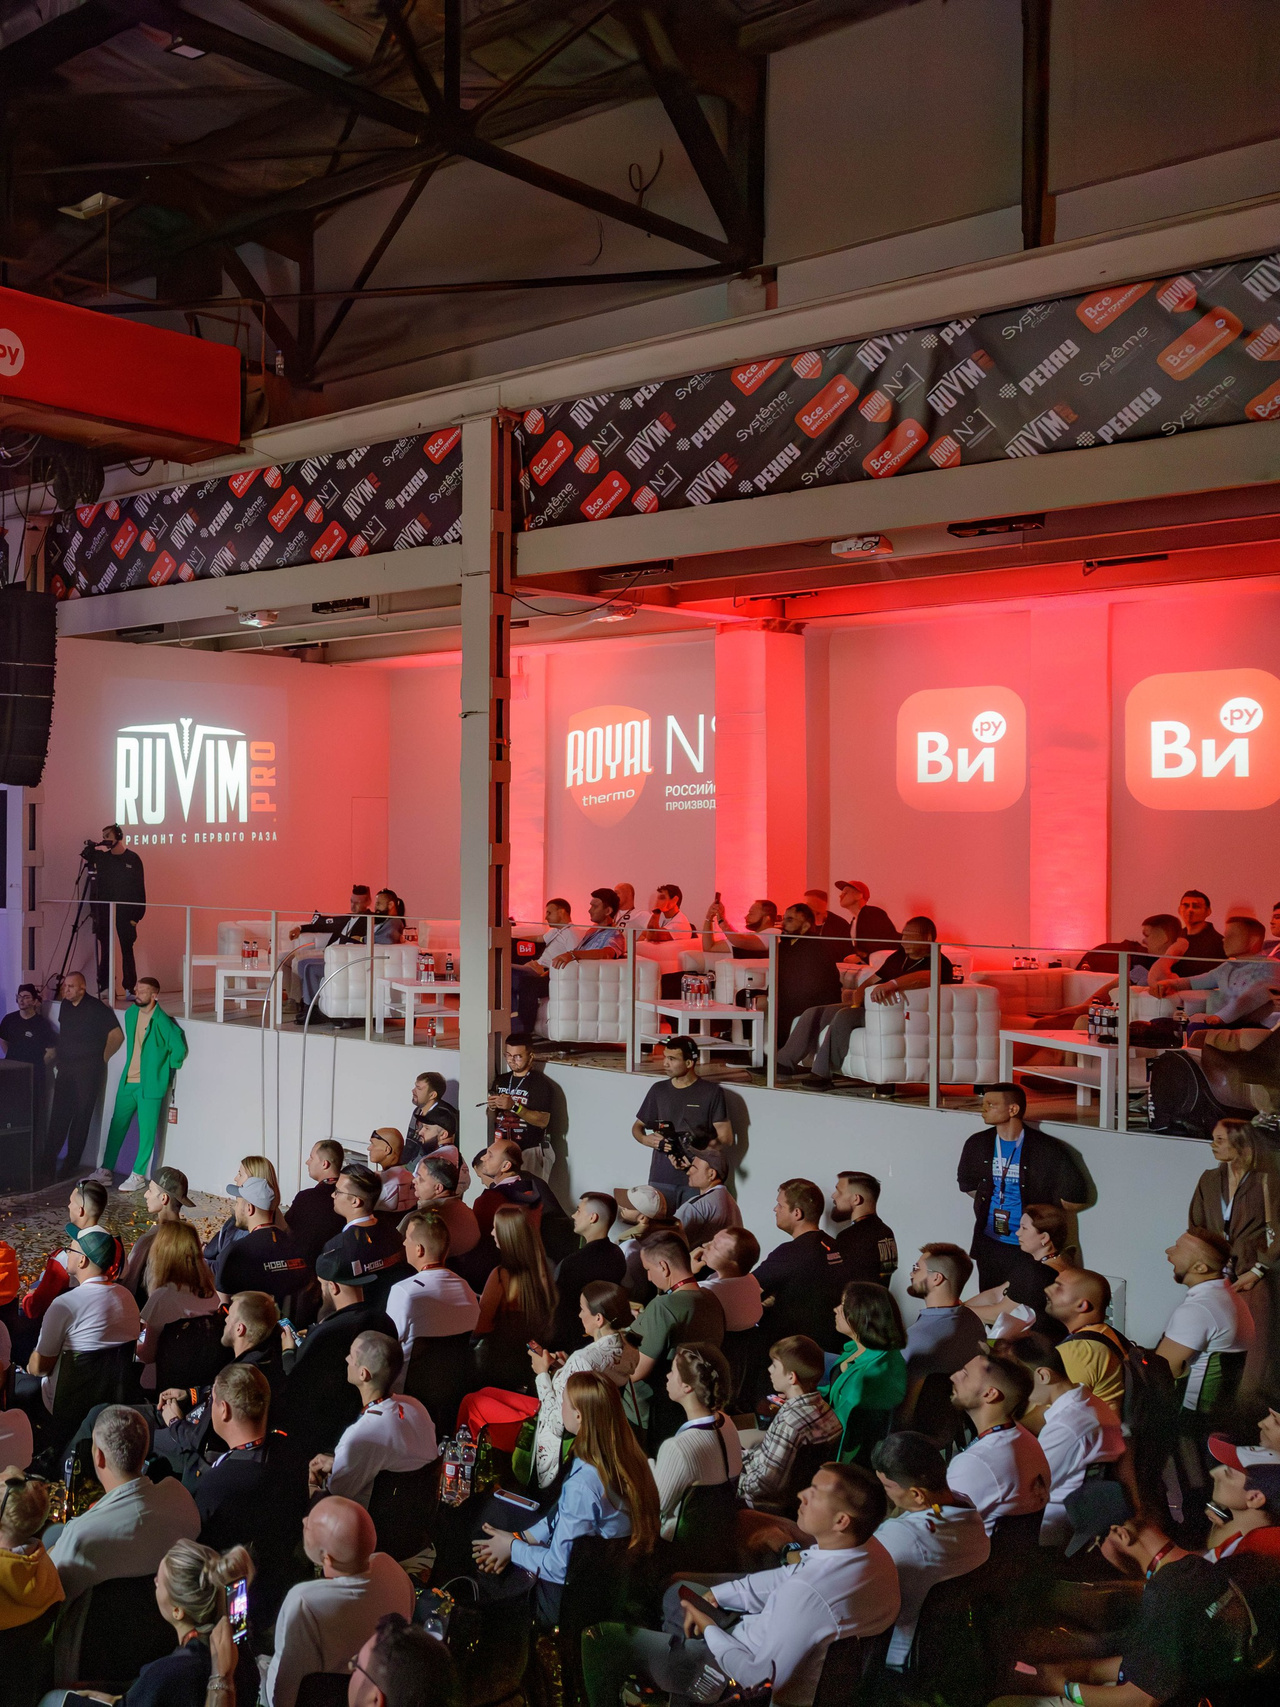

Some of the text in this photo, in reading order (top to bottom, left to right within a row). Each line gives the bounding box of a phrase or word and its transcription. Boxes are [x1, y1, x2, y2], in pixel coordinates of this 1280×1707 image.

[926, 357, 987, 417] RUVIM
[625, 419, 672, 469] RUVIM
[116, 720, 248, 825] RUVIM
[566, 718, 653, 789] ROYAL
[917, 731, 995, 783] Ви
[1151, 720, 1249, 778] Ви
[582, 788, 635, 807] thermo
[125, 831, 277, 845] РЕМОНТ С ПЕРВОГО РАЗА
